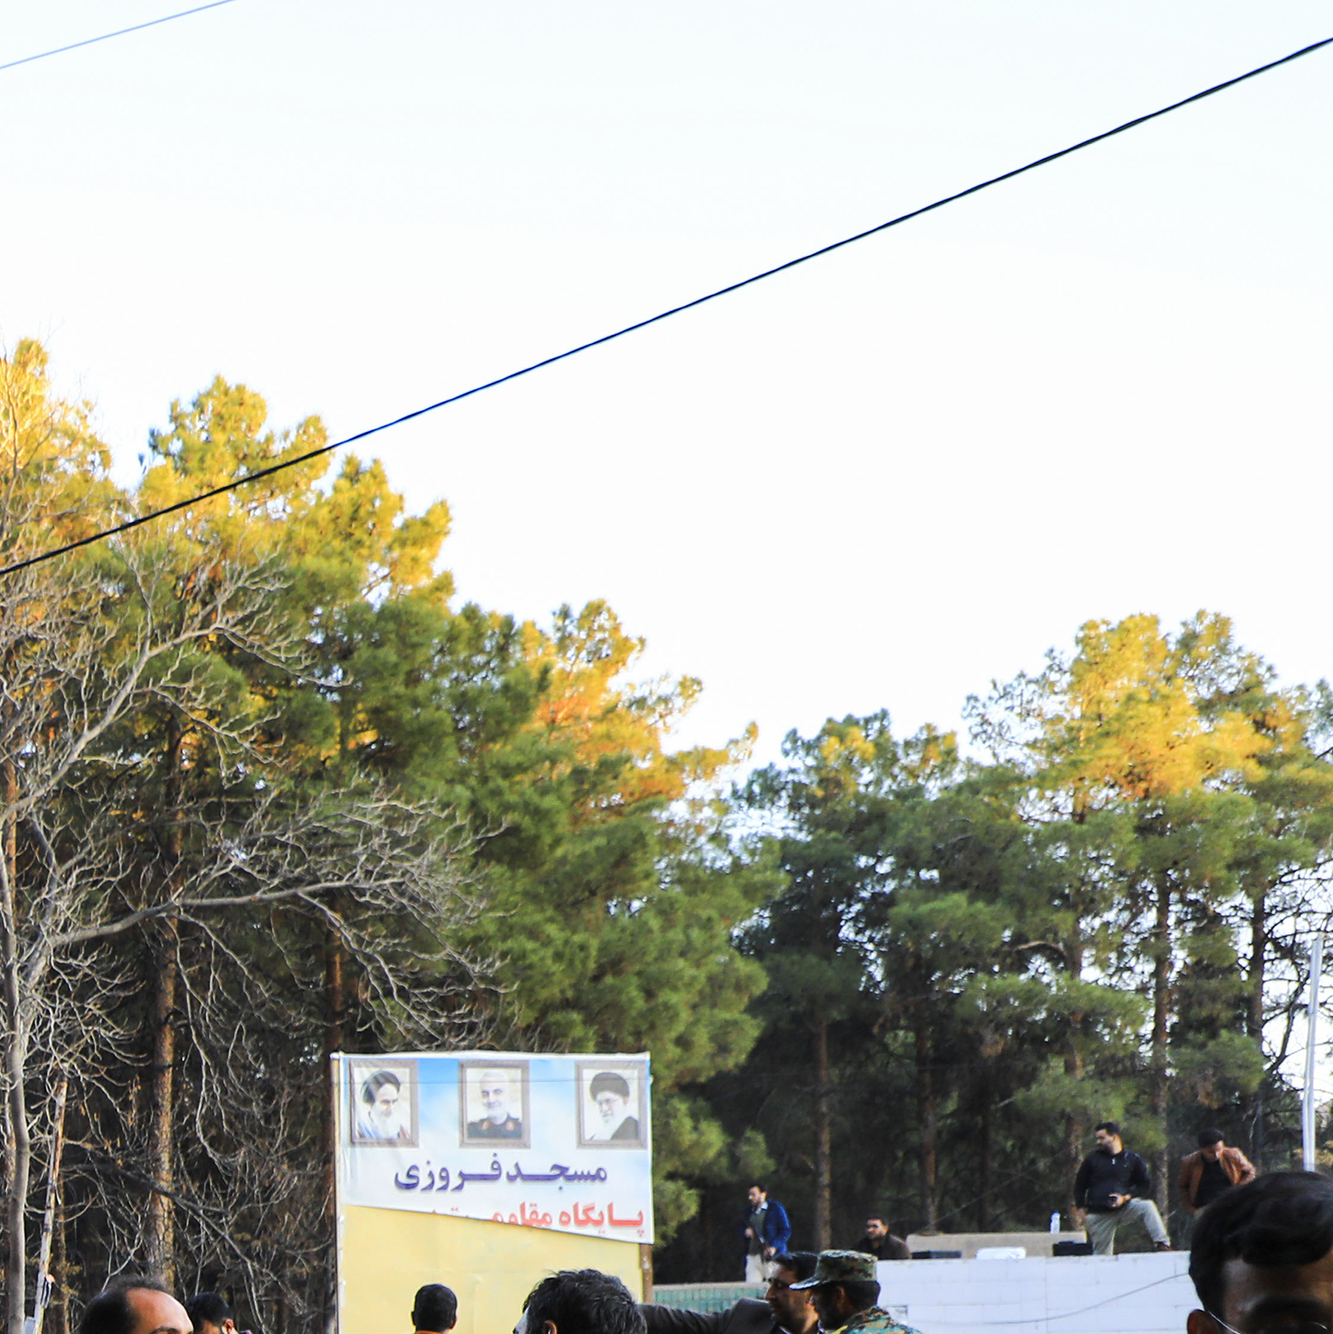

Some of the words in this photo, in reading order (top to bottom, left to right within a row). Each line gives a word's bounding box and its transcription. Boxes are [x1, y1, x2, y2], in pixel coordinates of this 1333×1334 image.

[394, 1152, 503, 1192] فروزی
[506, 1158, 608, 1191] مسجد
[558, 1201, 644, 1237] پایگاه
